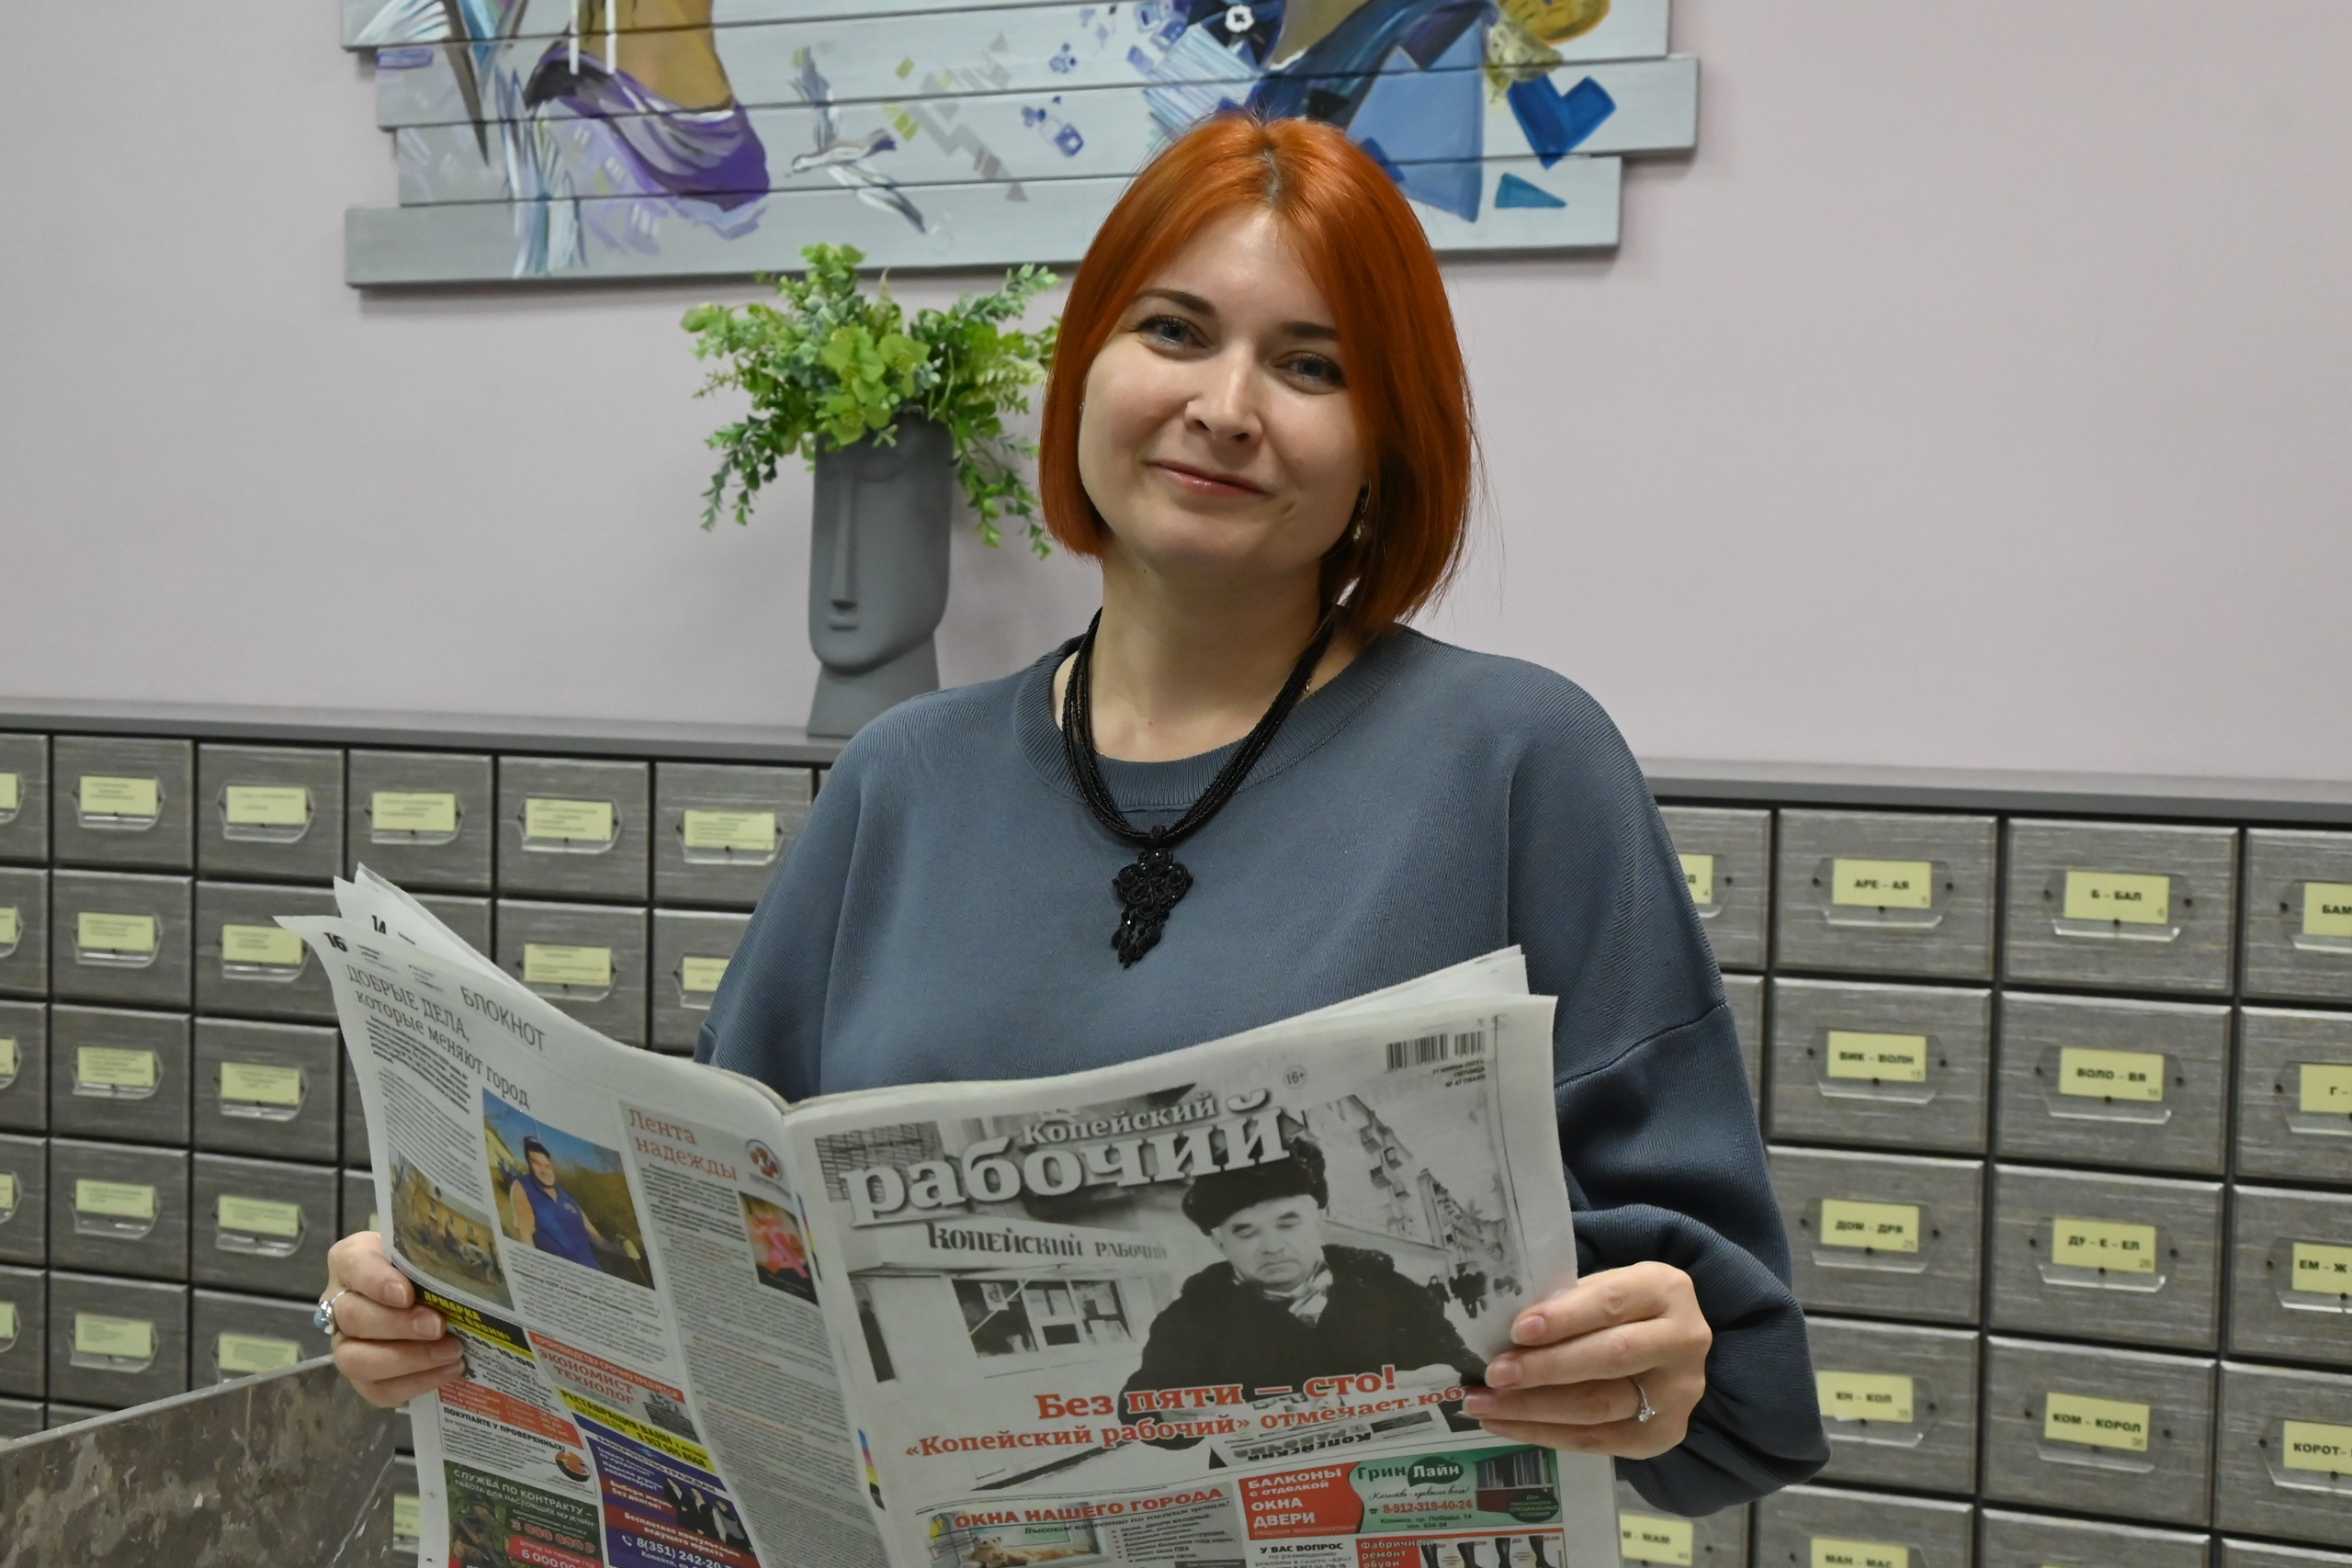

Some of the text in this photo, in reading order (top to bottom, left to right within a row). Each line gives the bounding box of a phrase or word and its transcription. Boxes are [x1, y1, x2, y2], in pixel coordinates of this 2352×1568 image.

[1853, 880, 1910, 891] АРЕ АЯ
[2090, 888, 2143, 901] Б БАЛ
[323, 932, 348, 953] 16
[345, 964, 419, 1010] ДОБРЫЕ
[421, 998, 470, 1044] ДЕЛА,
[460, 986, 547, 1052] БЛОКНОТ
[356, 990, 425, 1035] которые
[428, 1030, 484, 1075] меняют
[486, 1066, 530, 1110] город
[2076, 1067, 2147, 1082] ВОЛО ВЯ
[2330, 1086, 2337, 1096] Г
[628, 1108, 697, 1145] Лента
[1023, 1090, 1217, 1146] Копейский
[634, 1136, 739, 1181] надежды
[839, 1088, 1292, 1229] рабочий
[2068, 1235, 2140, 1250] ДУ Е ЕЛ
[2299, 1259, 2346, 1273] ЕМ Ж
[553, 1365, 635, 1404] ТЕХНОЛОГ
[1034, 1393, 1115, 1421] Без
[1125, 1383, 1245, 1416] пяти
[1302, 1364, 1396, 1402] сто!
[559, 1388, 638, 1430] РЕСТАВРАЦИЯ
[639, 1423, 673, 1446] ВАНН
[905, 1386, 1464, 1458] «Копейский рабочий» отмечает юб
[2052, 1412, 2142, 1432] КОМ КОРОЛ
[444, 1406, 492, 1428] ПОКУПАЙТЕ
[492, 1422, 499, 1430] У
[500, 1426, 566, 1452] ПРОВЕРЕННЫХ!
[1248, 1467, 1342, 1490] БАЛКОНЫ
[1357, 1463, 1461, 1483] Грин Лайн
[453, 1468, 583, 1516] СЛУЖБА ПО КОНТРАКТУ
[610, 1480, 645, 1497] Выбери
[612, 1487, 662, 1511] без долгов!
[1260, 1480, 1330, 1495] отделкой
[455, 1479, 594, 1528] РАБОТА ДЛЯ НАСТОЯЩИХ МУЖЧИН
[954, 1511, 1022, 1529] ОКНА
[1024, 1500, 1125, 1522] НАШЕГО
[1130, 1488, 1225, 1513] ГОРОДА
[1251, 1496, 1304, 1512] ОКНА
[625, 1511, 676, 1535] Бесплатная
[1252, 1511, 1316, 1529] ДВЕРИ
[524, 1523, 553, 1541] 000
[554, 1532, 584, 1551] 000
[636, 1537, 676, 1559] 8(351)
[644, 1527, 724, 1558] ведущего юриста
[1271, 1545, 1294, 1553] ВАС
[1296, 1542, 1344, 1552] ВОПРОС
[521, 1549, 530, 1560] 6
[532, 1552, 559, 1568] 000
[1362, 1551, 1407, 1561] ремонт
[1363, 1559, 1401, 1568] обуви
